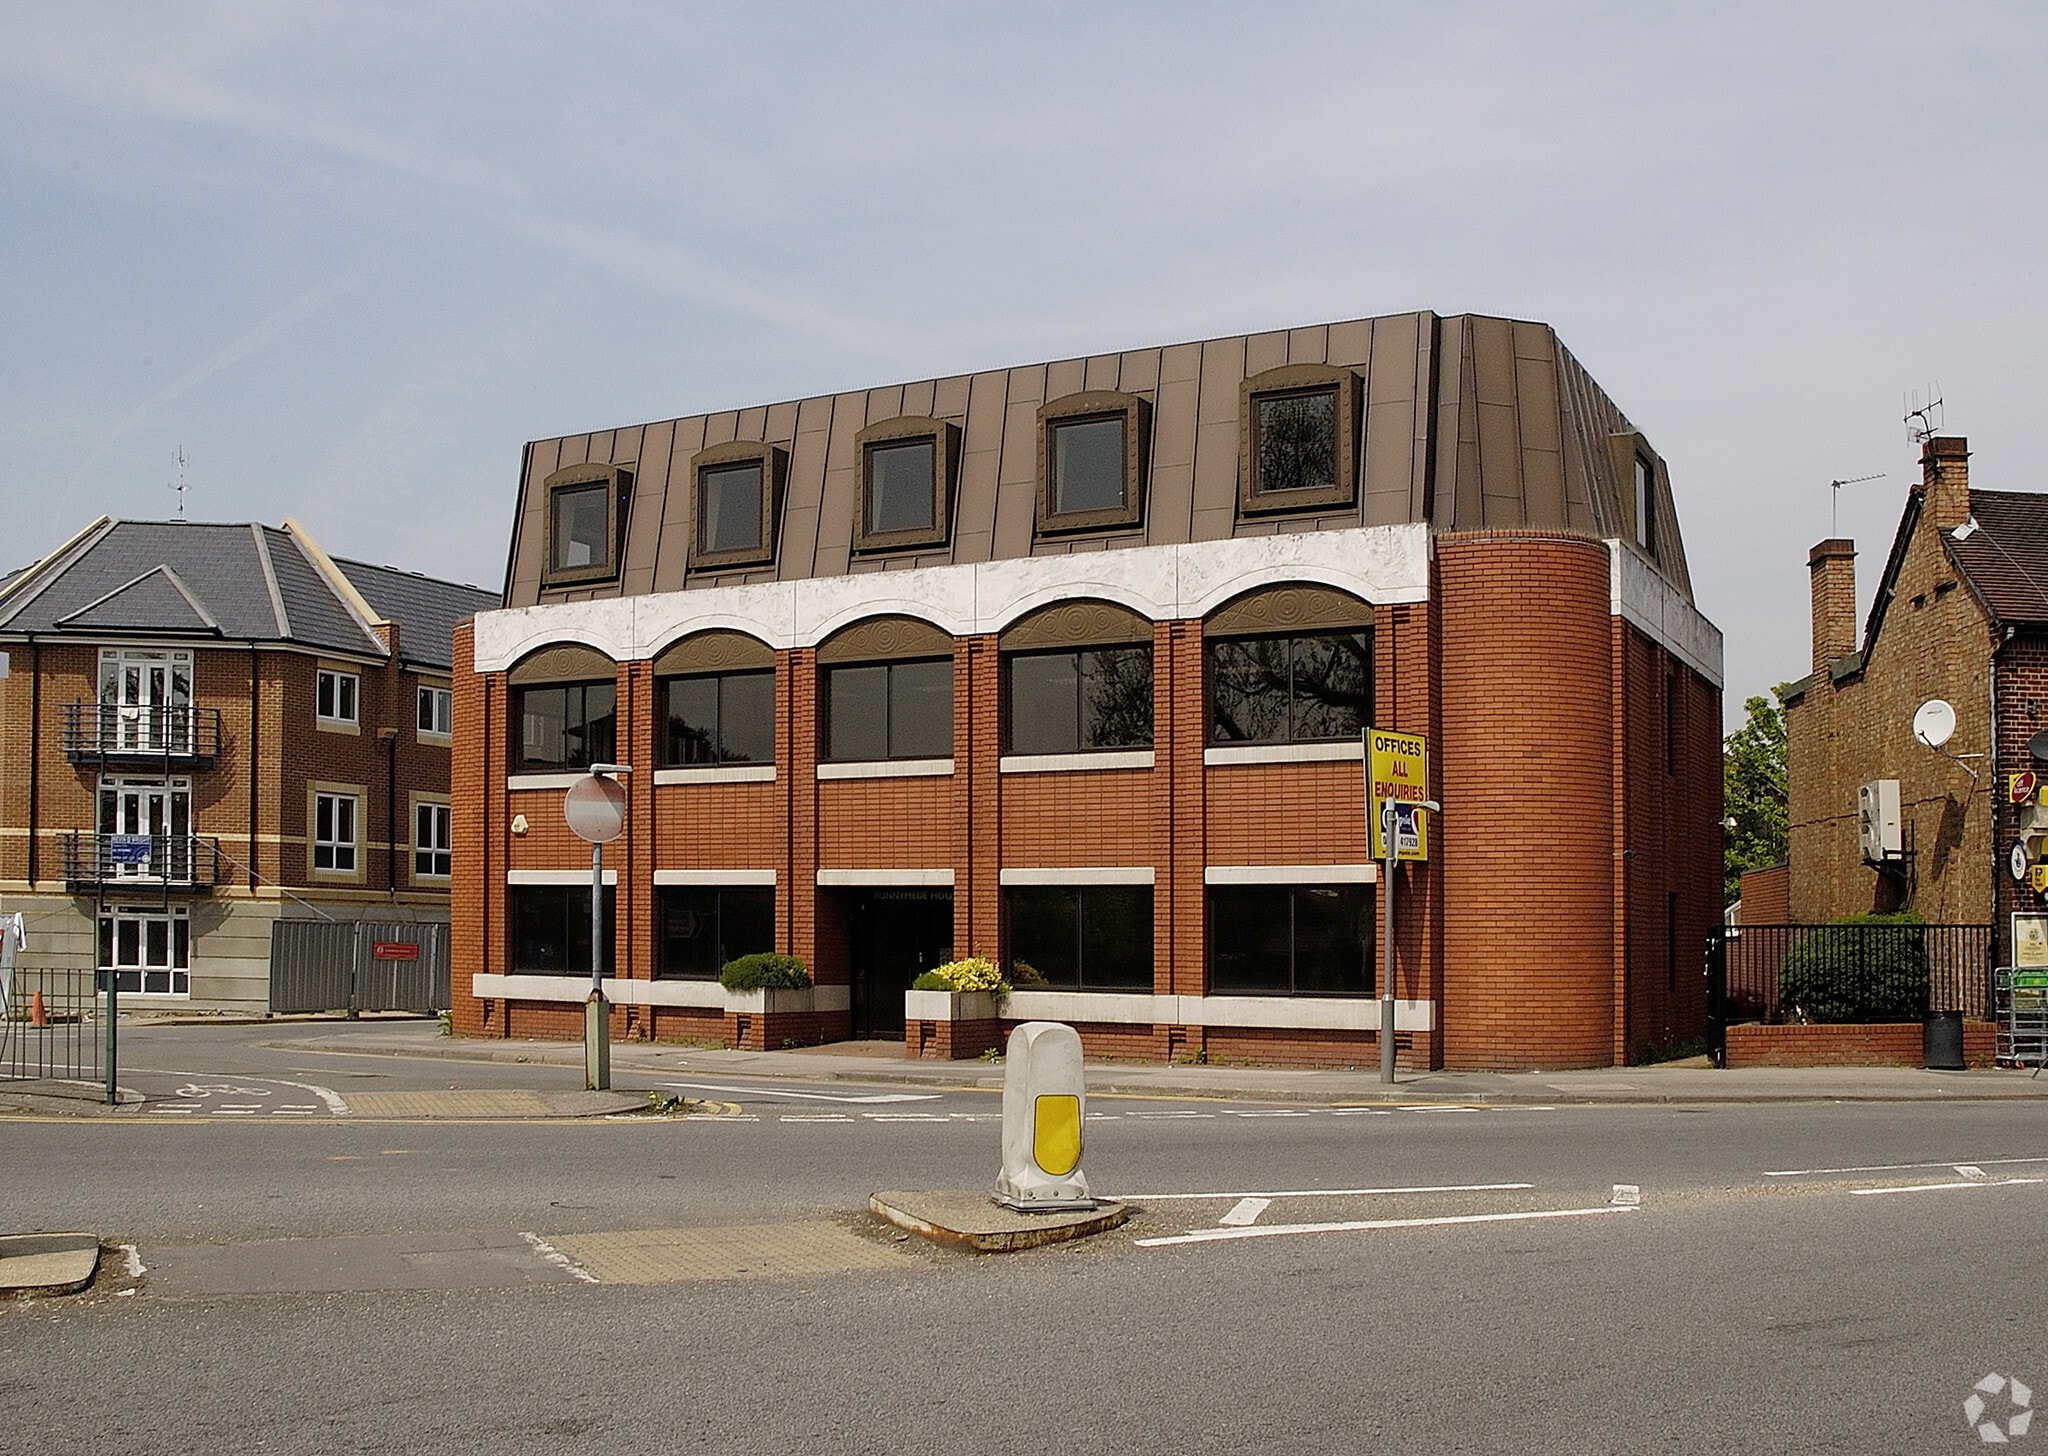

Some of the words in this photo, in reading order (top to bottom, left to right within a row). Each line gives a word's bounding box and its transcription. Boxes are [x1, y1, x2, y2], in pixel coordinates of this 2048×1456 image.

[1375, 736, 1421, 757] OFFICES
[1392, 760, 1408, 778] ALL
[1374, 781, 1425, 802] ENQUIRIES
[930, 891, 953, 900] HOU
